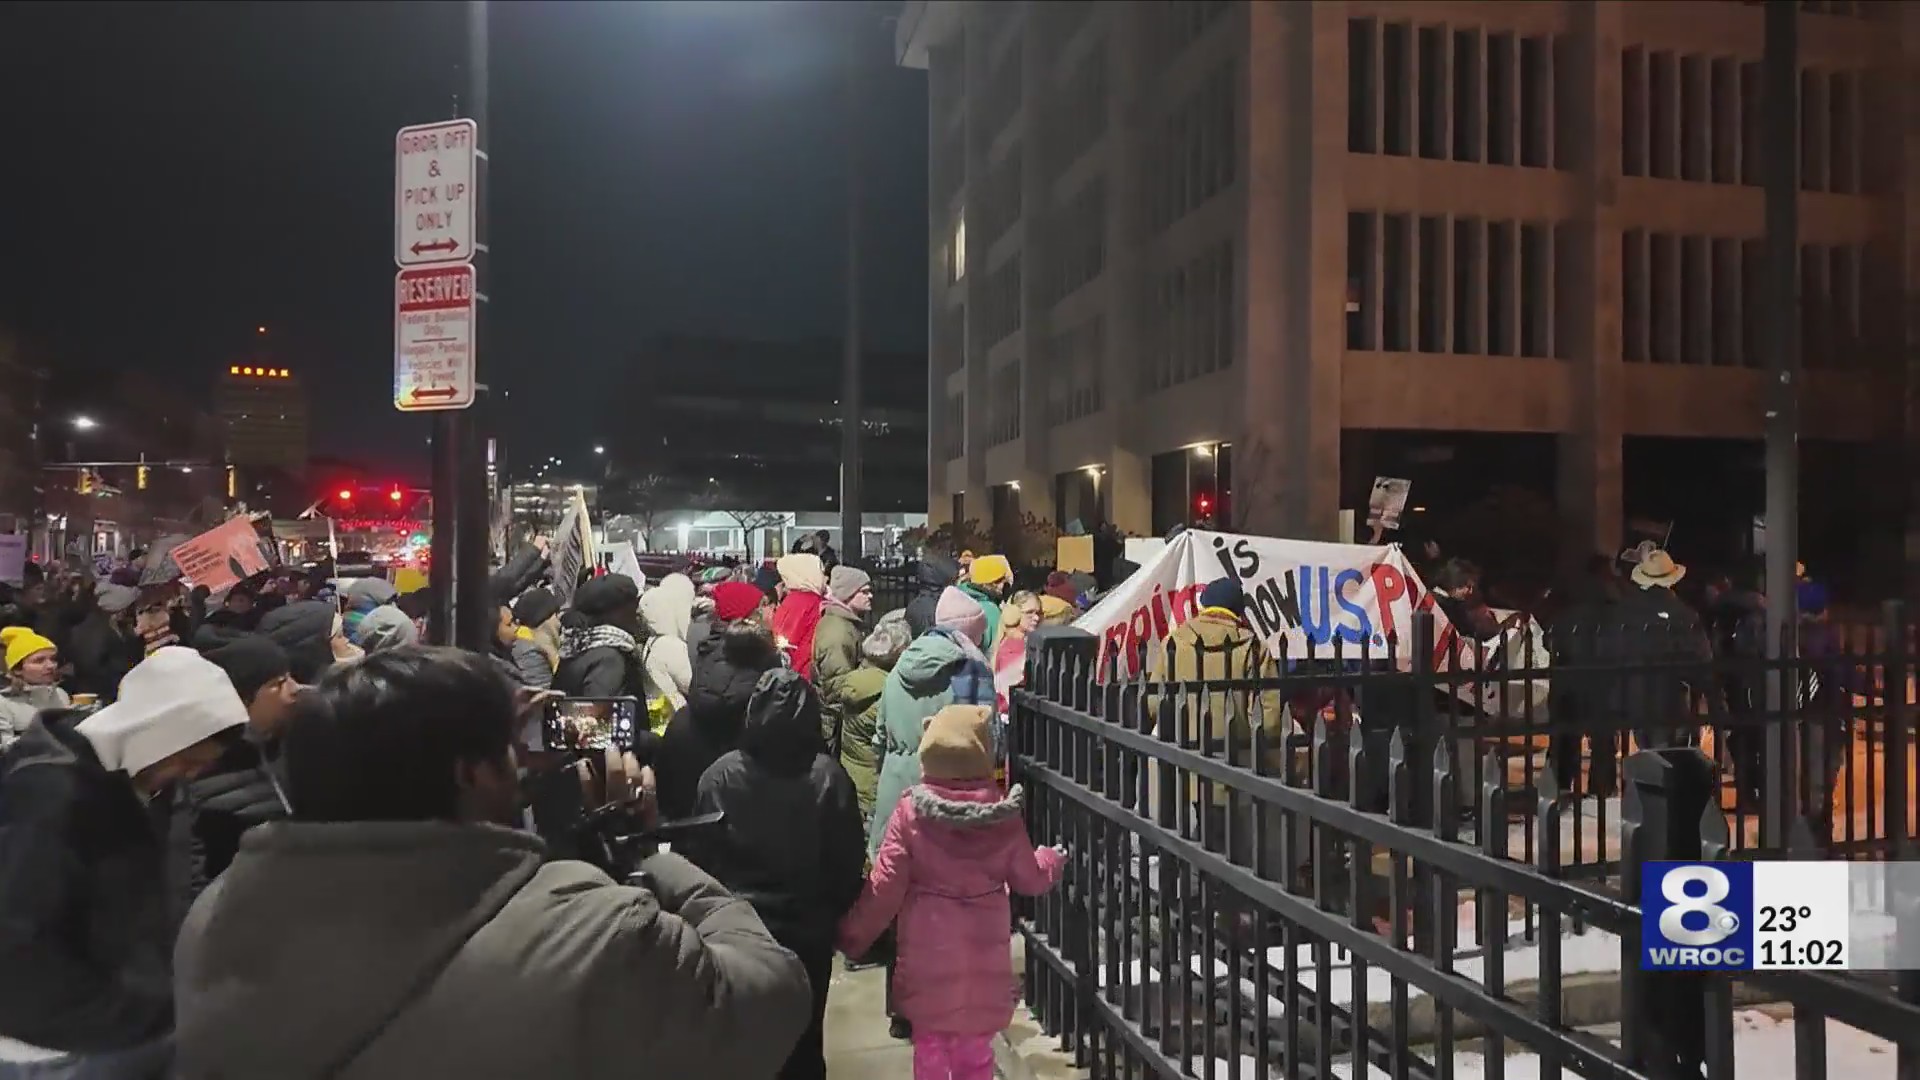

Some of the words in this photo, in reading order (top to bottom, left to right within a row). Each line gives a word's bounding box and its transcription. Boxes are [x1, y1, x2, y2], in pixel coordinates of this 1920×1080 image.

[445, 130, 468, 149] OFF
[428, 160, 441, 177] &
[405, 187, 438, 205] PICK
[446, 183, 465, 201] UP
[416, 211, 453, 231] ONLY
[401, 275, 470, 304] RESERVED
[1213, 536, 1260, 584] is
